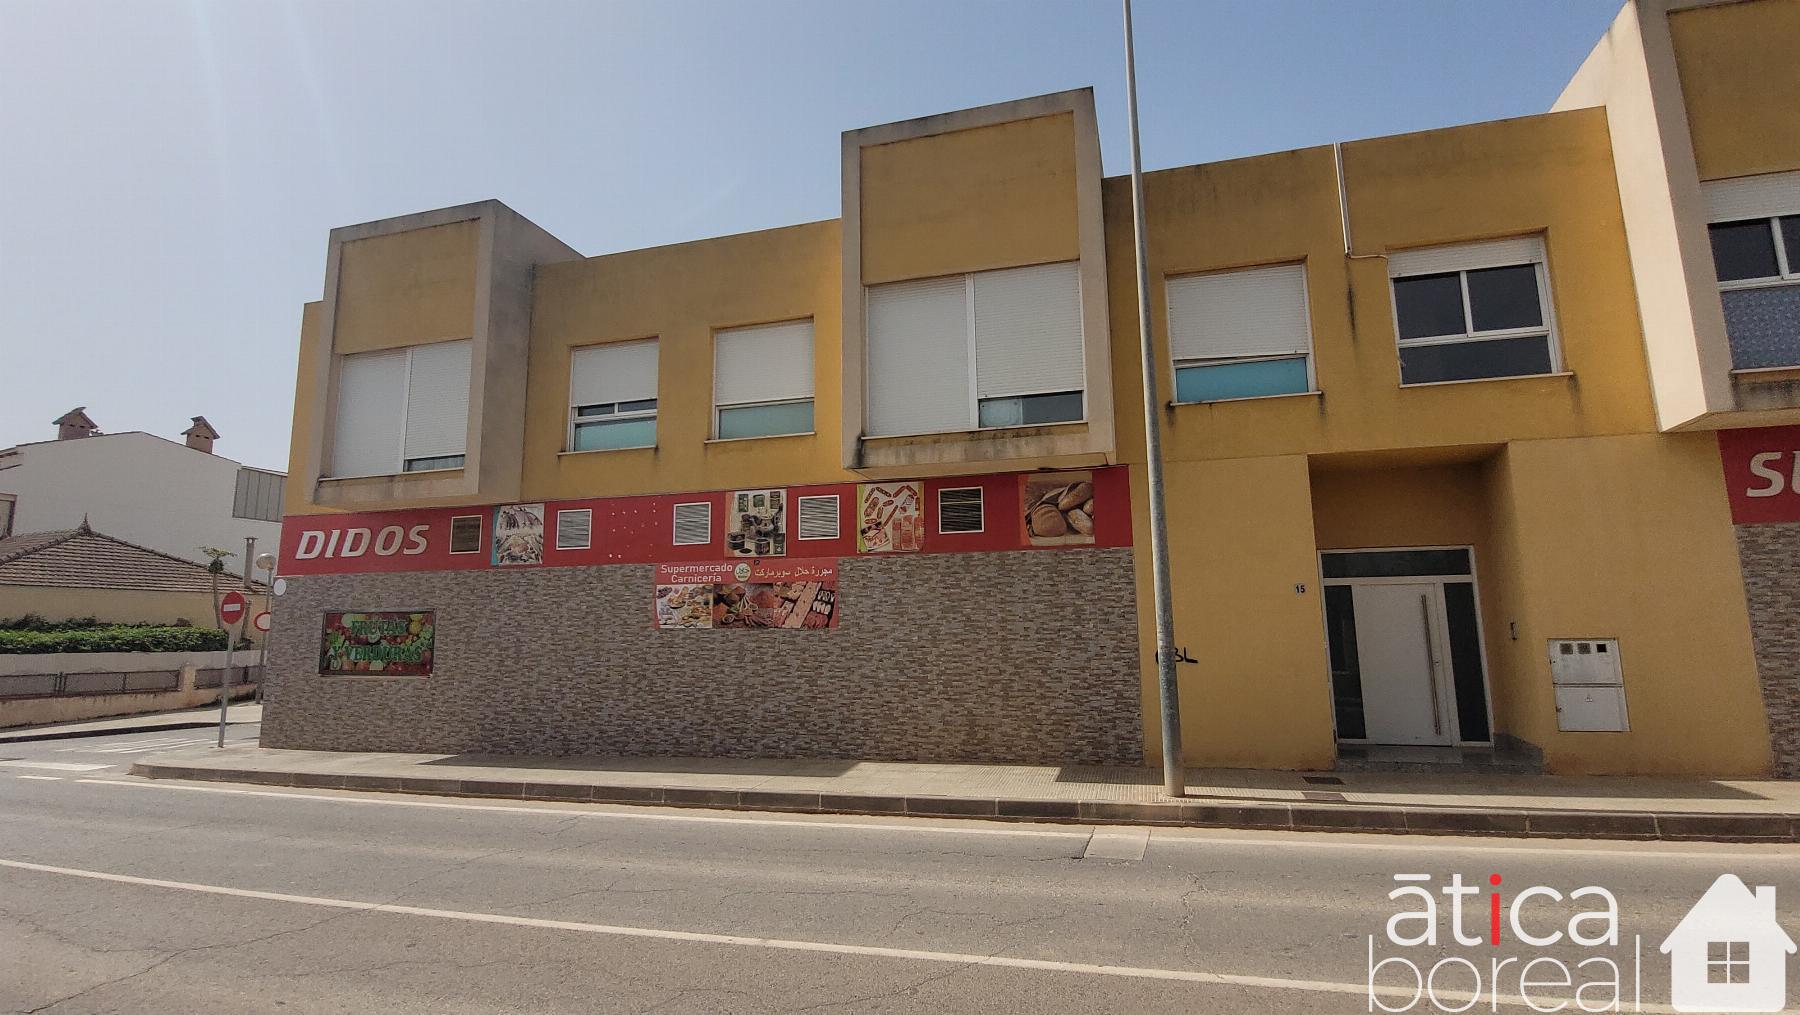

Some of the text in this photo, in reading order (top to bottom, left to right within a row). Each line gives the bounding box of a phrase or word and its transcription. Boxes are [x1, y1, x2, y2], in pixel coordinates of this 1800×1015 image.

[1746, 451, 1800, 498] S
[295, 524, 430, 560] DIDOS
[661, 563, 733, 574] Supermercado
[671, 572, 722, 583] Carnicería
[1296, 585, 1306, 593] 15
[344, 646, 423, 662] VERDURAS
